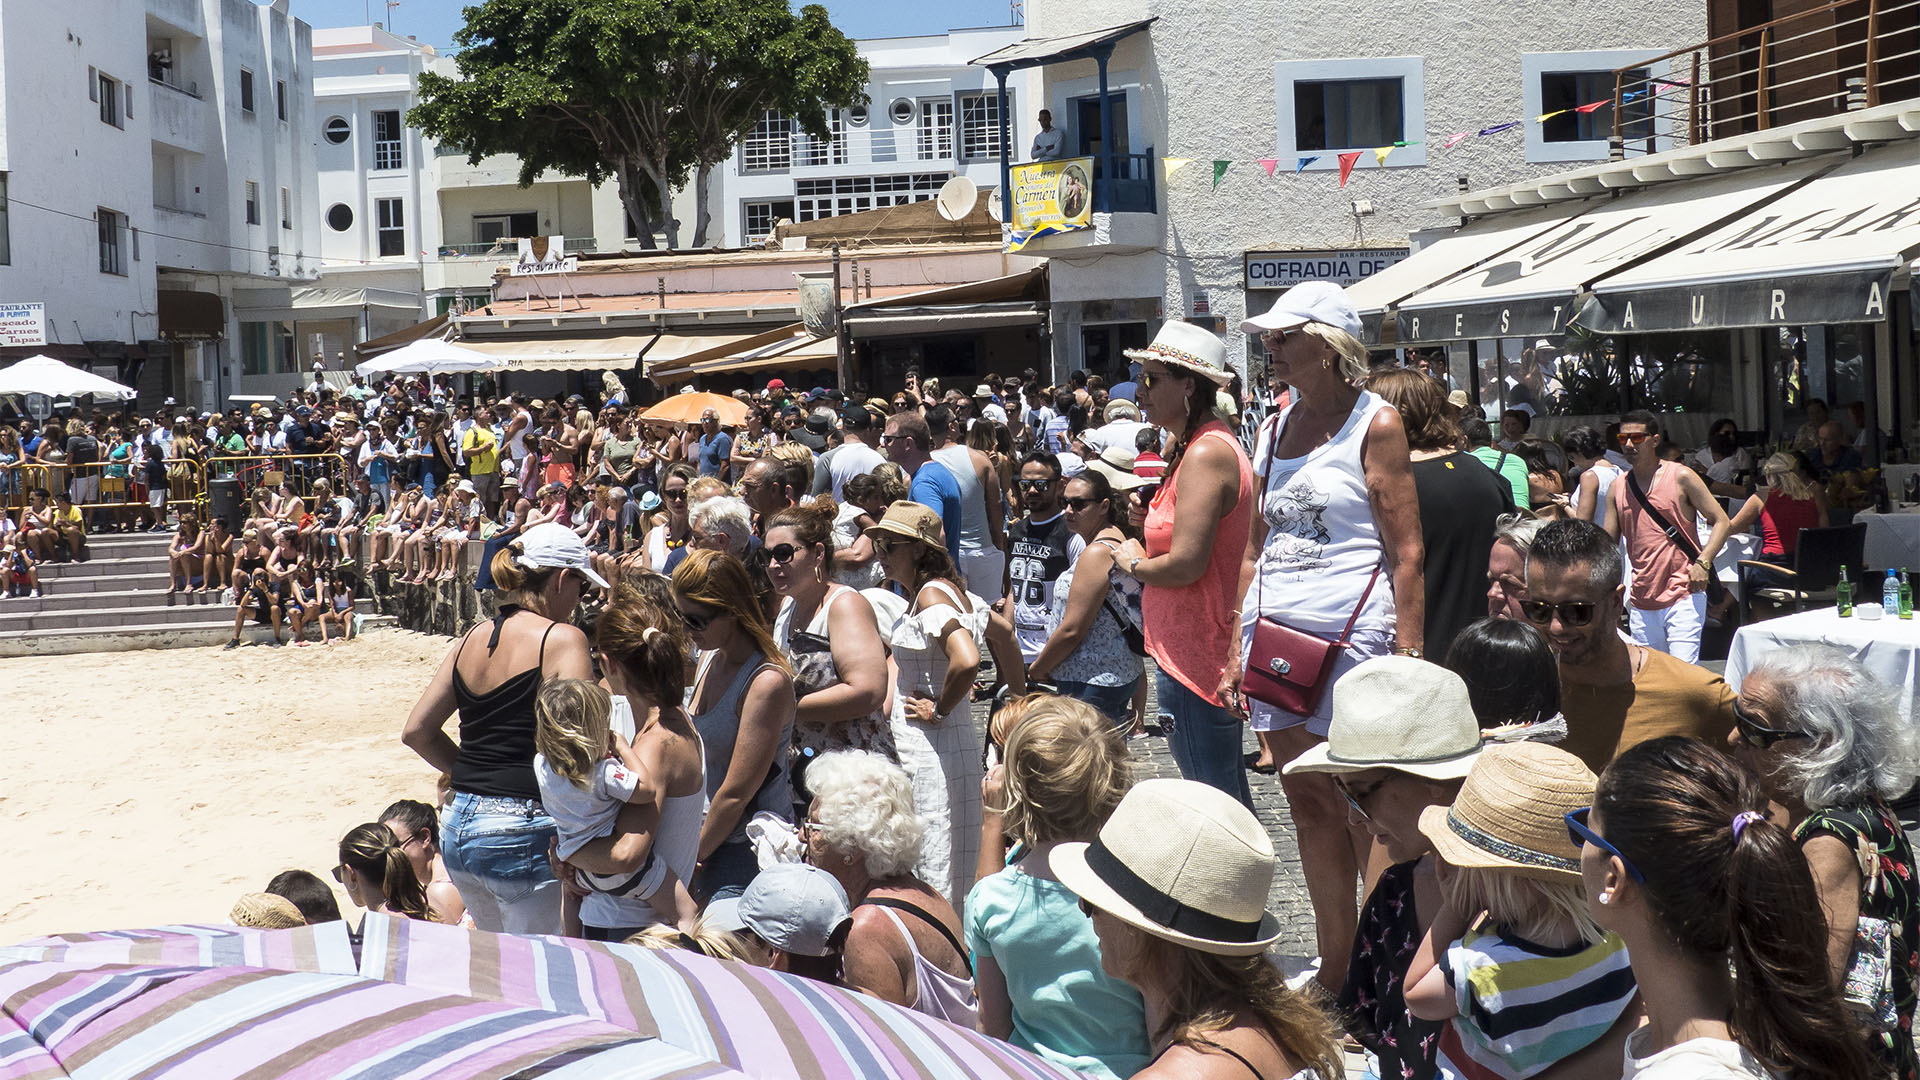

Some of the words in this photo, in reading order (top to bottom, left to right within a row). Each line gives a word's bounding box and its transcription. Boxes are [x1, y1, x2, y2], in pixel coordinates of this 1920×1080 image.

[1020, 167, 1056, 184] Nuestra
[1015, 186, 1056, 205] Carmen
[1249, 261, 1351, 279] COFRADIA
[1264, 279, 1298, 287] PESCADO
[8, 336, 41, 344] Tapas
